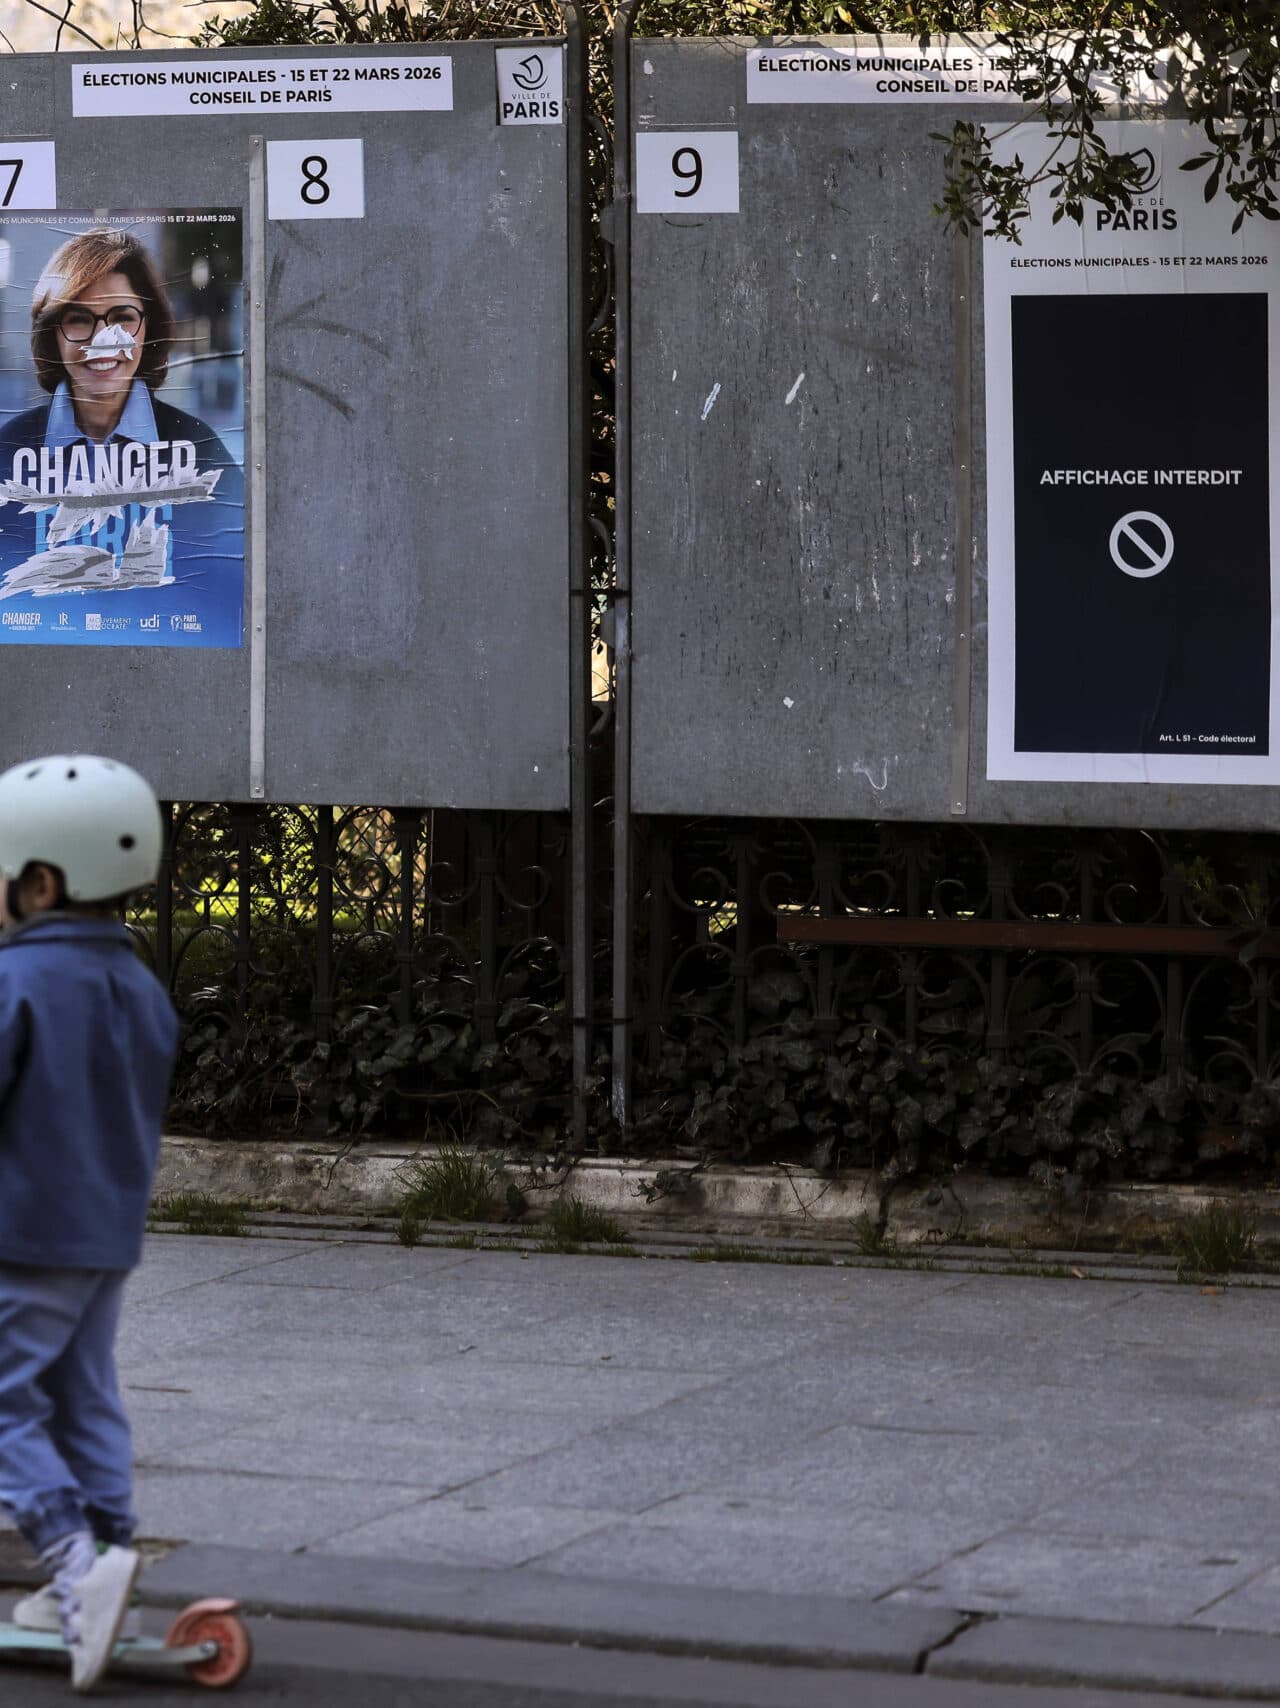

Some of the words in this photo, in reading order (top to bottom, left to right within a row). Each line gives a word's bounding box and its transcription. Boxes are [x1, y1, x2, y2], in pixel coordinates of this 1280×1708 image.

[758, 56, 851, 72] ÉLECTIONS
[856, 58, 973, 72] MUNICIPALES
[83, 71, 167, 87] ÉLECTIONS
[171, 69, 277, 85] MUNICIPALES
[290, 69, 305, 82] 15
[310, 69, 328, 82] ET
[333, 68, 350, 81] 22
[355, 67, 400, 81] MARS
[404, 66, 442, 80] 2026
[876, 80, 949, 93] CONSEIL
[955, 80, 978, 92] DE
[189, 91, 256, 105] CONSEIL
[260, 90, 281, 104] DE
[286, 89, 332, 103] PARIS
[503, 101, 559, 119] PARIS
[301, 156, 329, 204] 8
[672, 148, 702, 197] 9
[1150, 198, 1164, 206] DE
[11, 216, 57, 225] MUNICIPALES
[59, 216, 67, 224] ET
[146, 215, 166, 223] PARIS
[167, 215, 174, 223] 15
[176, 215, 185, 223] ET
[218, 214, 236, 222] 2026
[1096, 208, 1177, 231] PARIS
[1011, 256, 1071, 268] ÉLECTIONS
[1077, 257, 1149, 267] MUNICIPALES
[1160, 257, 1170, 266] 15
[1173, 256, 1186, 266] ET
[1190, 256, 1202, 266] 22
[1205, 256, 1238, 266] MARS
[1241, 255, 1268, 265] 2026
[1040, 470, 1149, 485] AFFICHAGE
[1154, 470, 1243, 485] INTERDIT
[140, 613, 160, 628] udi
[1159, 734, 1175, 742] Art.
[1176, 734, 1181, 742] L
[1198, 734, 1220, 742] Code
[1220, 735, 1256, 743] électoral
